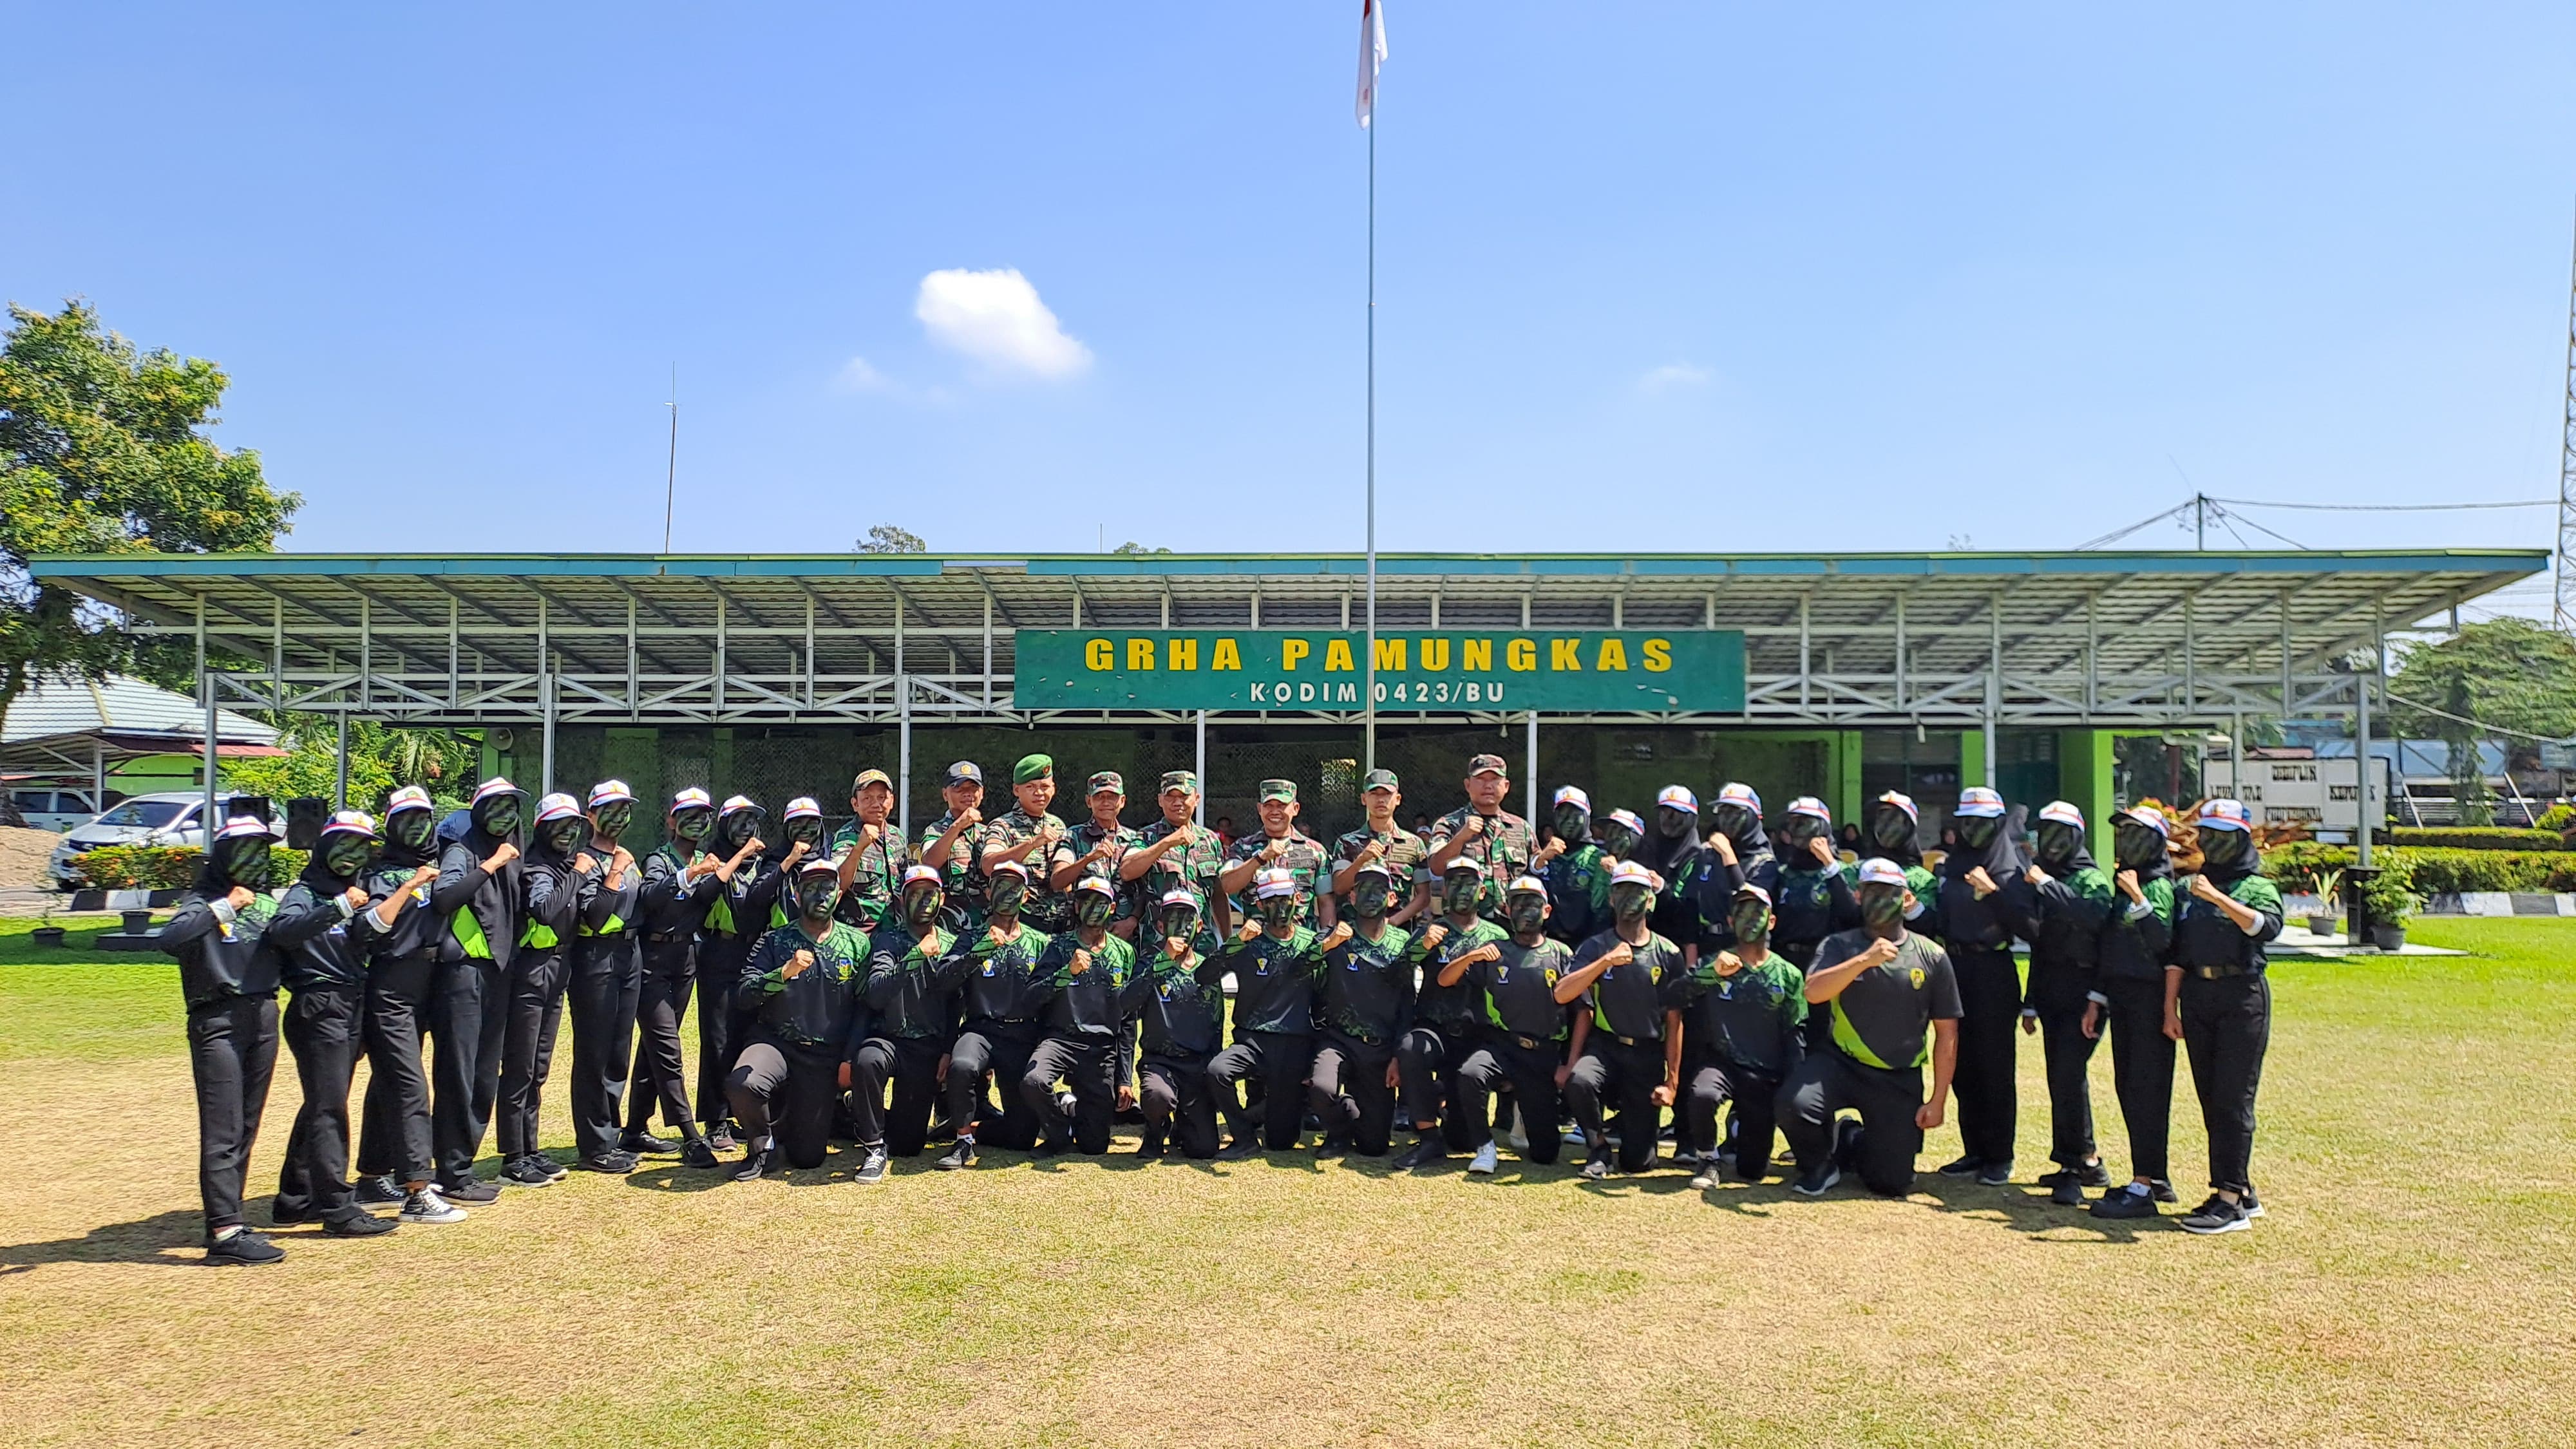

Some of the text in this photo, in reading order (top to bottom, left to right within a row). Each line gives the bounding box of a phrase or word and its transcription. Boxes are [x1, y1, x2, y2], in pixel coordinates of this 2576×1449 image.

[1085, 638, 1672, 672] GRHA PAMUNGKAS
[1251, 683, 1504, 703] KODIM 0423/BU
